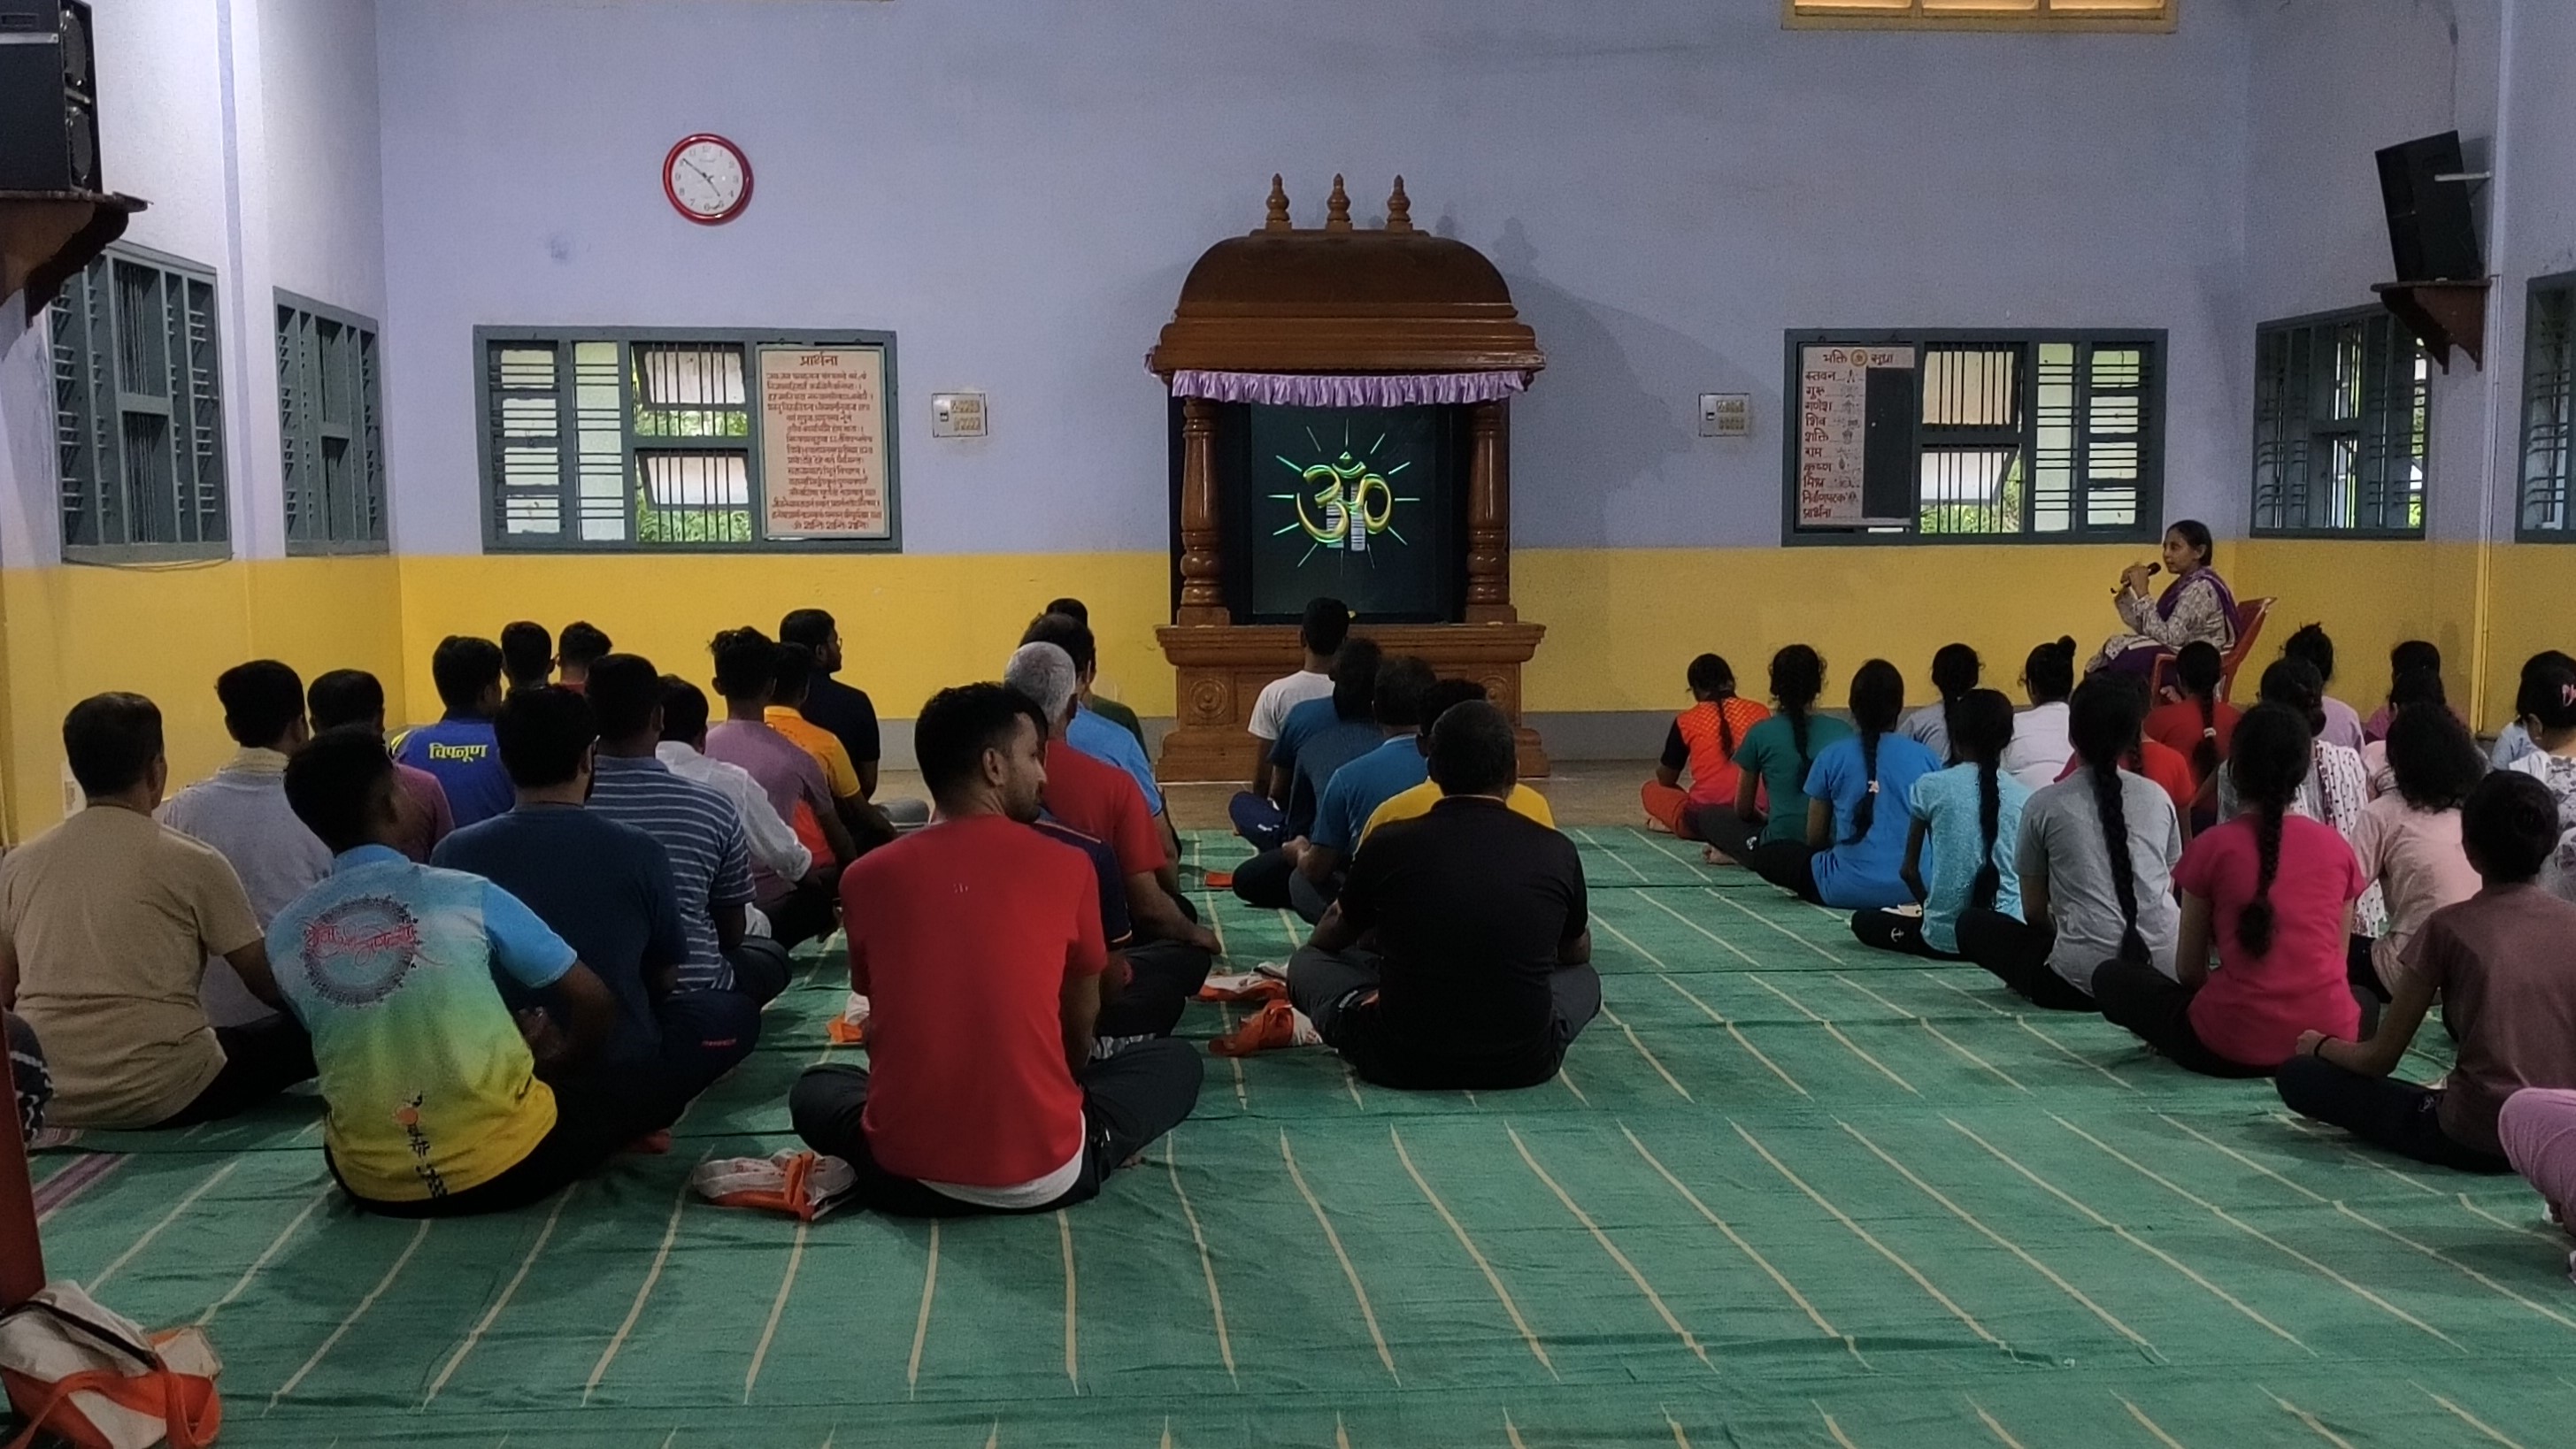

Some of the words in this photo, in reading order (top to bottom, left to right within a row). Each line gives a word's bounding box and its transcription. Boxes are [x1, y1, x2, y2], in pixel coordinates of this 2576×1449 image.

[800, 352, 838, 366] प्रार्थना
[1823, 349, 1848, 364] भक्ति
[1805, 371, 1835, 381] स्तवन
[1804, 399, 1833, 412] गणेश
[1805, 412, 1826, 427] शिव
[1804, 427, 1829, 442] शक्ति
[1804, 447, 1822, 458] राम
[1803, 463, 1833, 476] कृष्ण
[1803, 504, 1832, 519] प्रार्थना
